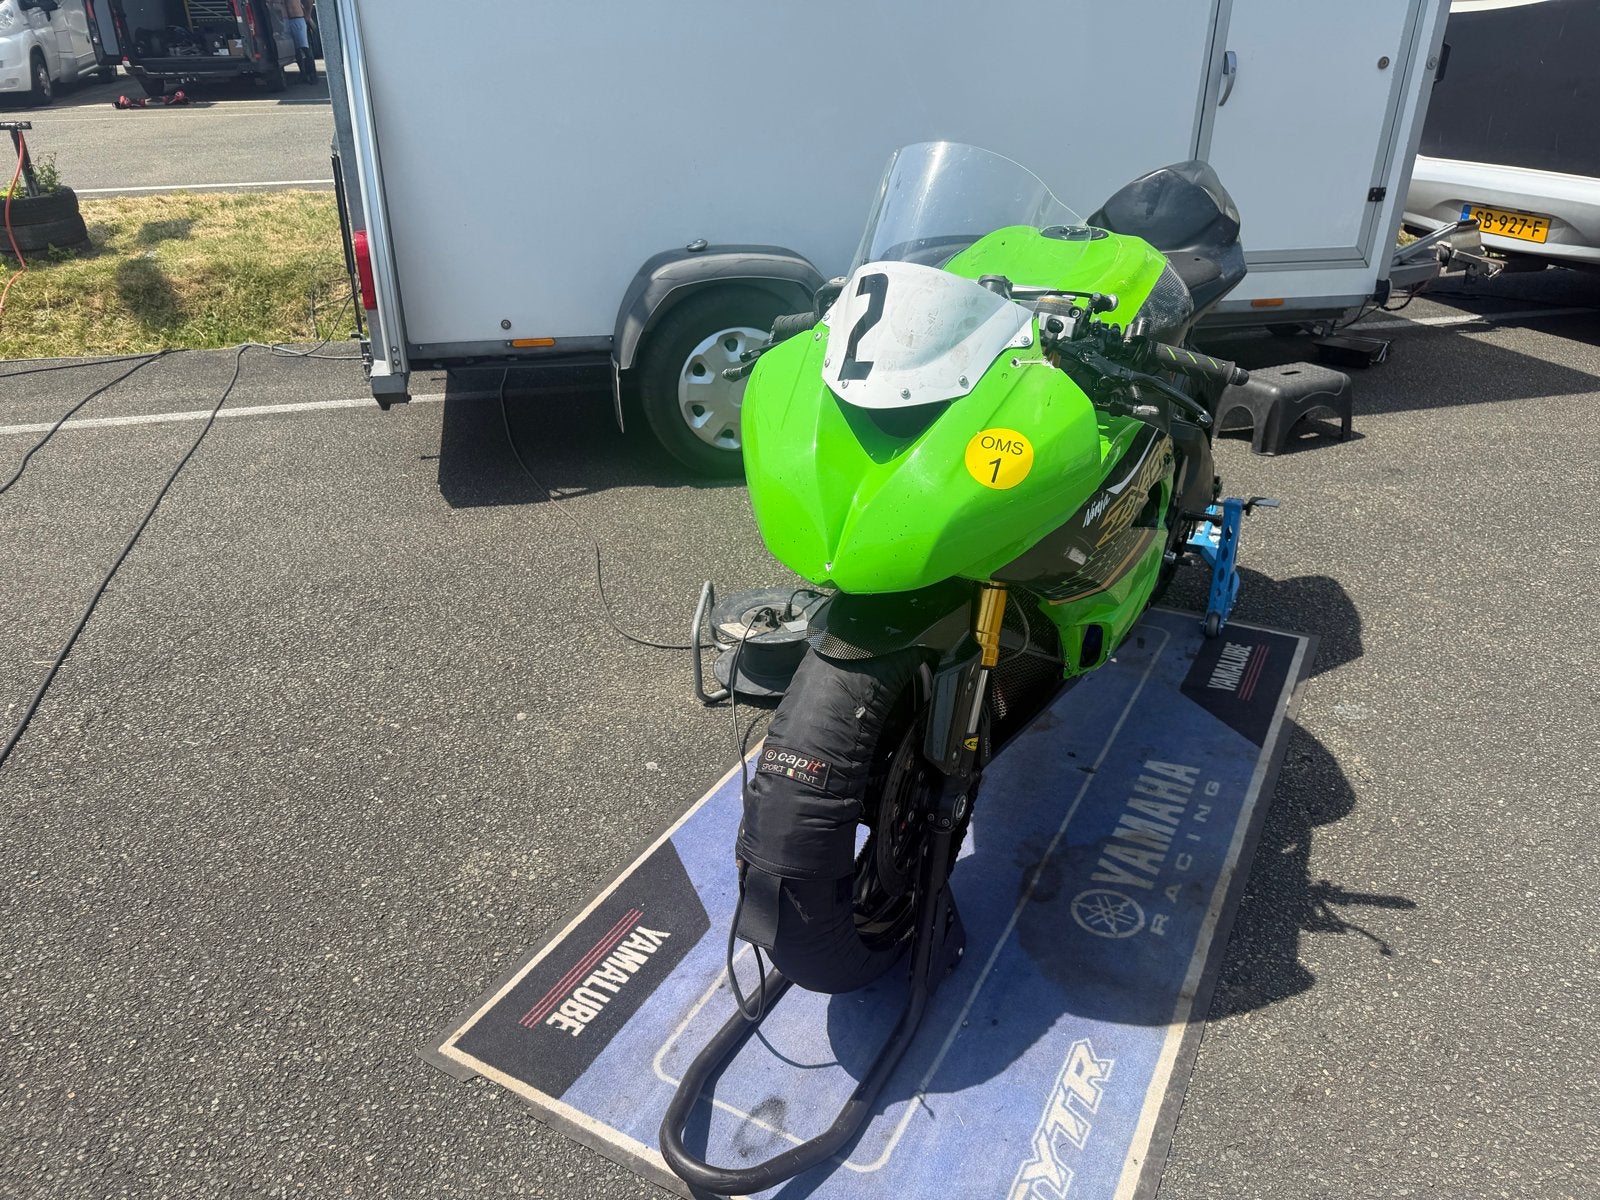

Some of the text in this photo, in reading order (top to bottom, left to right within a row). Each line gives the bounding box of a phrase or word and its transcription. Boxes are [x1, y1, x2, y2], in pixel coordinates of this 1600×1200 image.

[1475, 211, 1543, 238] SB-927-F
[837, 272, 890, 382] 2
[980, 435, 1025, 456] OMS
[988, 457, 1002, 484] 1
[1082, 492, 1111, 529] Ninja
[1206, 641, 1253, 691] YAMALUBE
[761, 763, 819, 784] SPORT TNT
[1090, 759, 1201, 891] YAMAHA
[545, 925, 671, 1037] YAMALUBE
